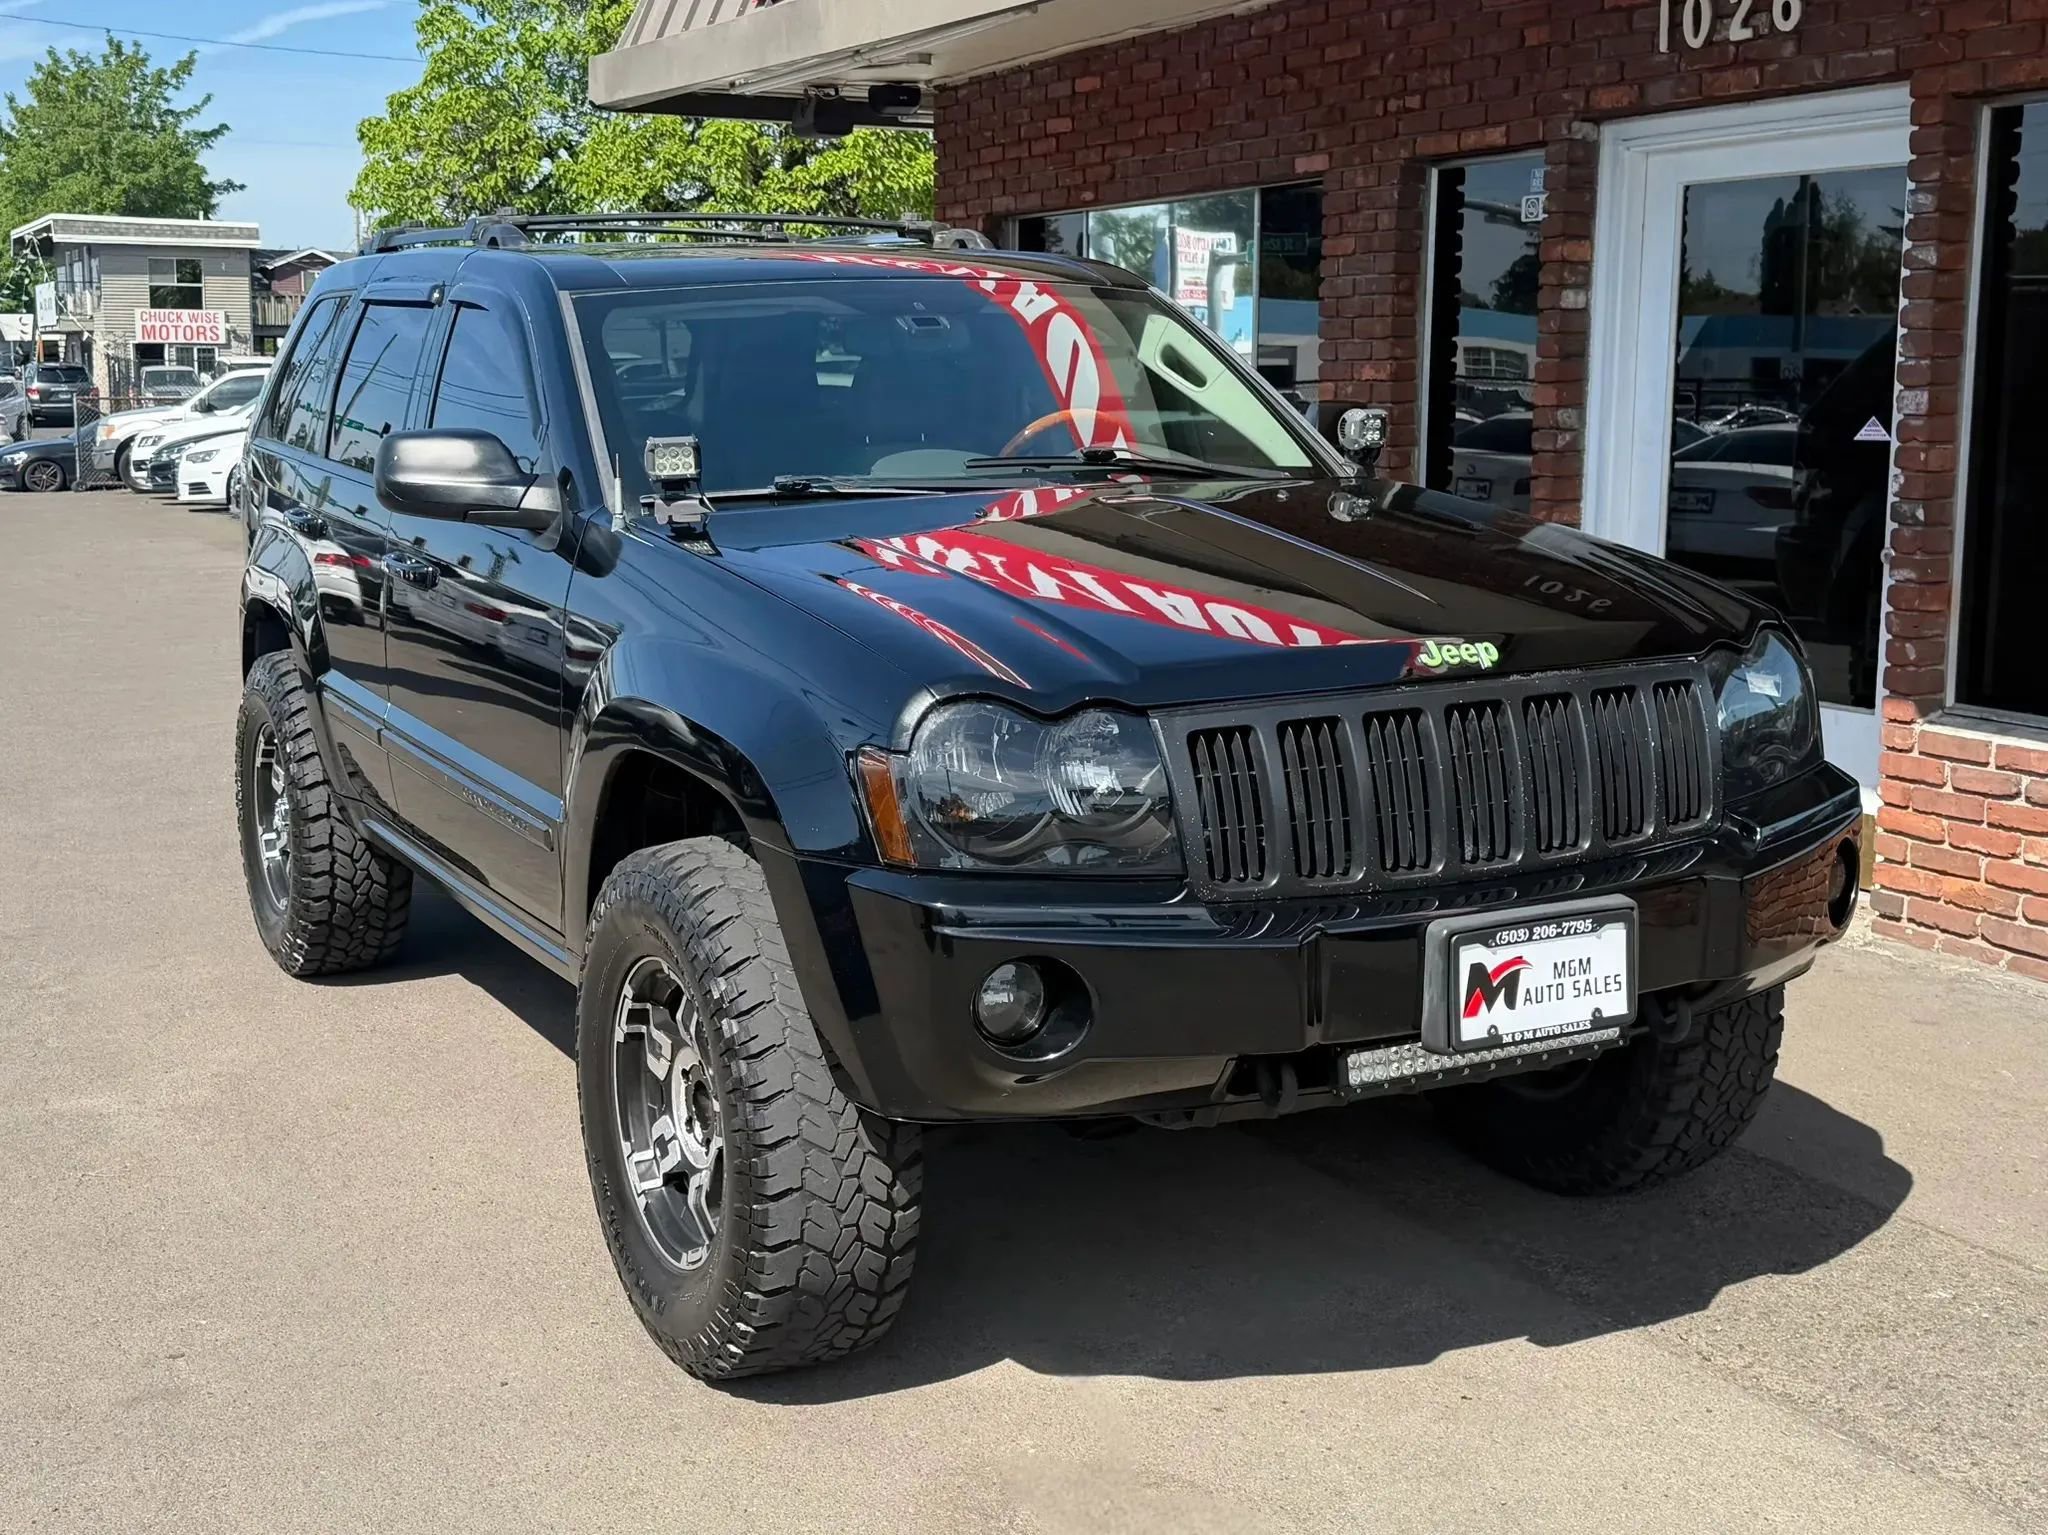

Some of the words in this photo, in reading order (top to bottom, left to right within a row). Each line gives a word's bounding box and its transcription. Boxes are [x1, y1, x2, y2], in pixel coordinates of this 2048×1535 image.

[140, 311, 183, 323] CHUCK
[188, 312, 220, 324] WISE
[141, 324, 220, 341] MOTORS
[1417, 640, 1499, 670] Jeep
[1495, 931, 1529, 946] (503)
[1532, 919, 1593, 940] 206-7795
[1523, 982, 1565, 1006] AUTO
[1573, 974, 1622, 998] SALES
[1502, 1032, 1514, 1044] M
[1523, 1030, 1534, 1041] M
[1535, 1025, 1561, 1038] AUTO
[1562, 1020, 1592, 1034] SALES
